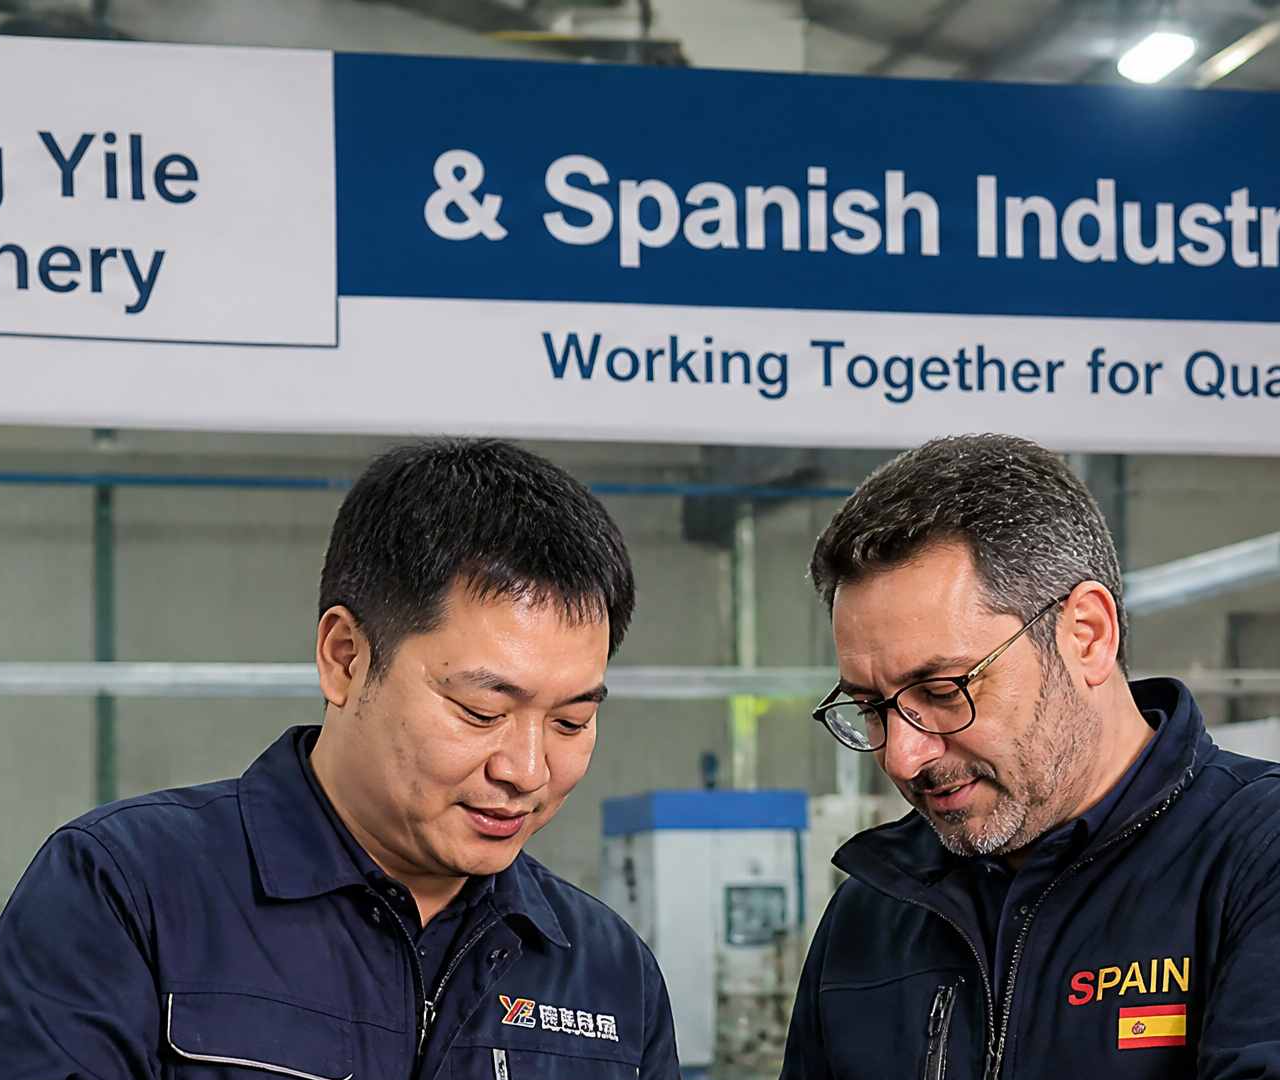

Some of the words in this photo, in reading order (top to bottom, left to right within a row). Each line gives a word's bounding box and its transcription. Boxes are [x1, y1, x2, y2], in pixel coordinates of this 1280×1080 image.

[38, 131, 199, 205] Yile
[424, 149, 508, 241] &
[543, 154, 940, 268] Spanish
[542, 331, 788, 400] Working
[809, 339, 1065, 404] Together
[1086, 347, 1164, 396] for
[1068, 957, 1191, 1006] SPAIN
